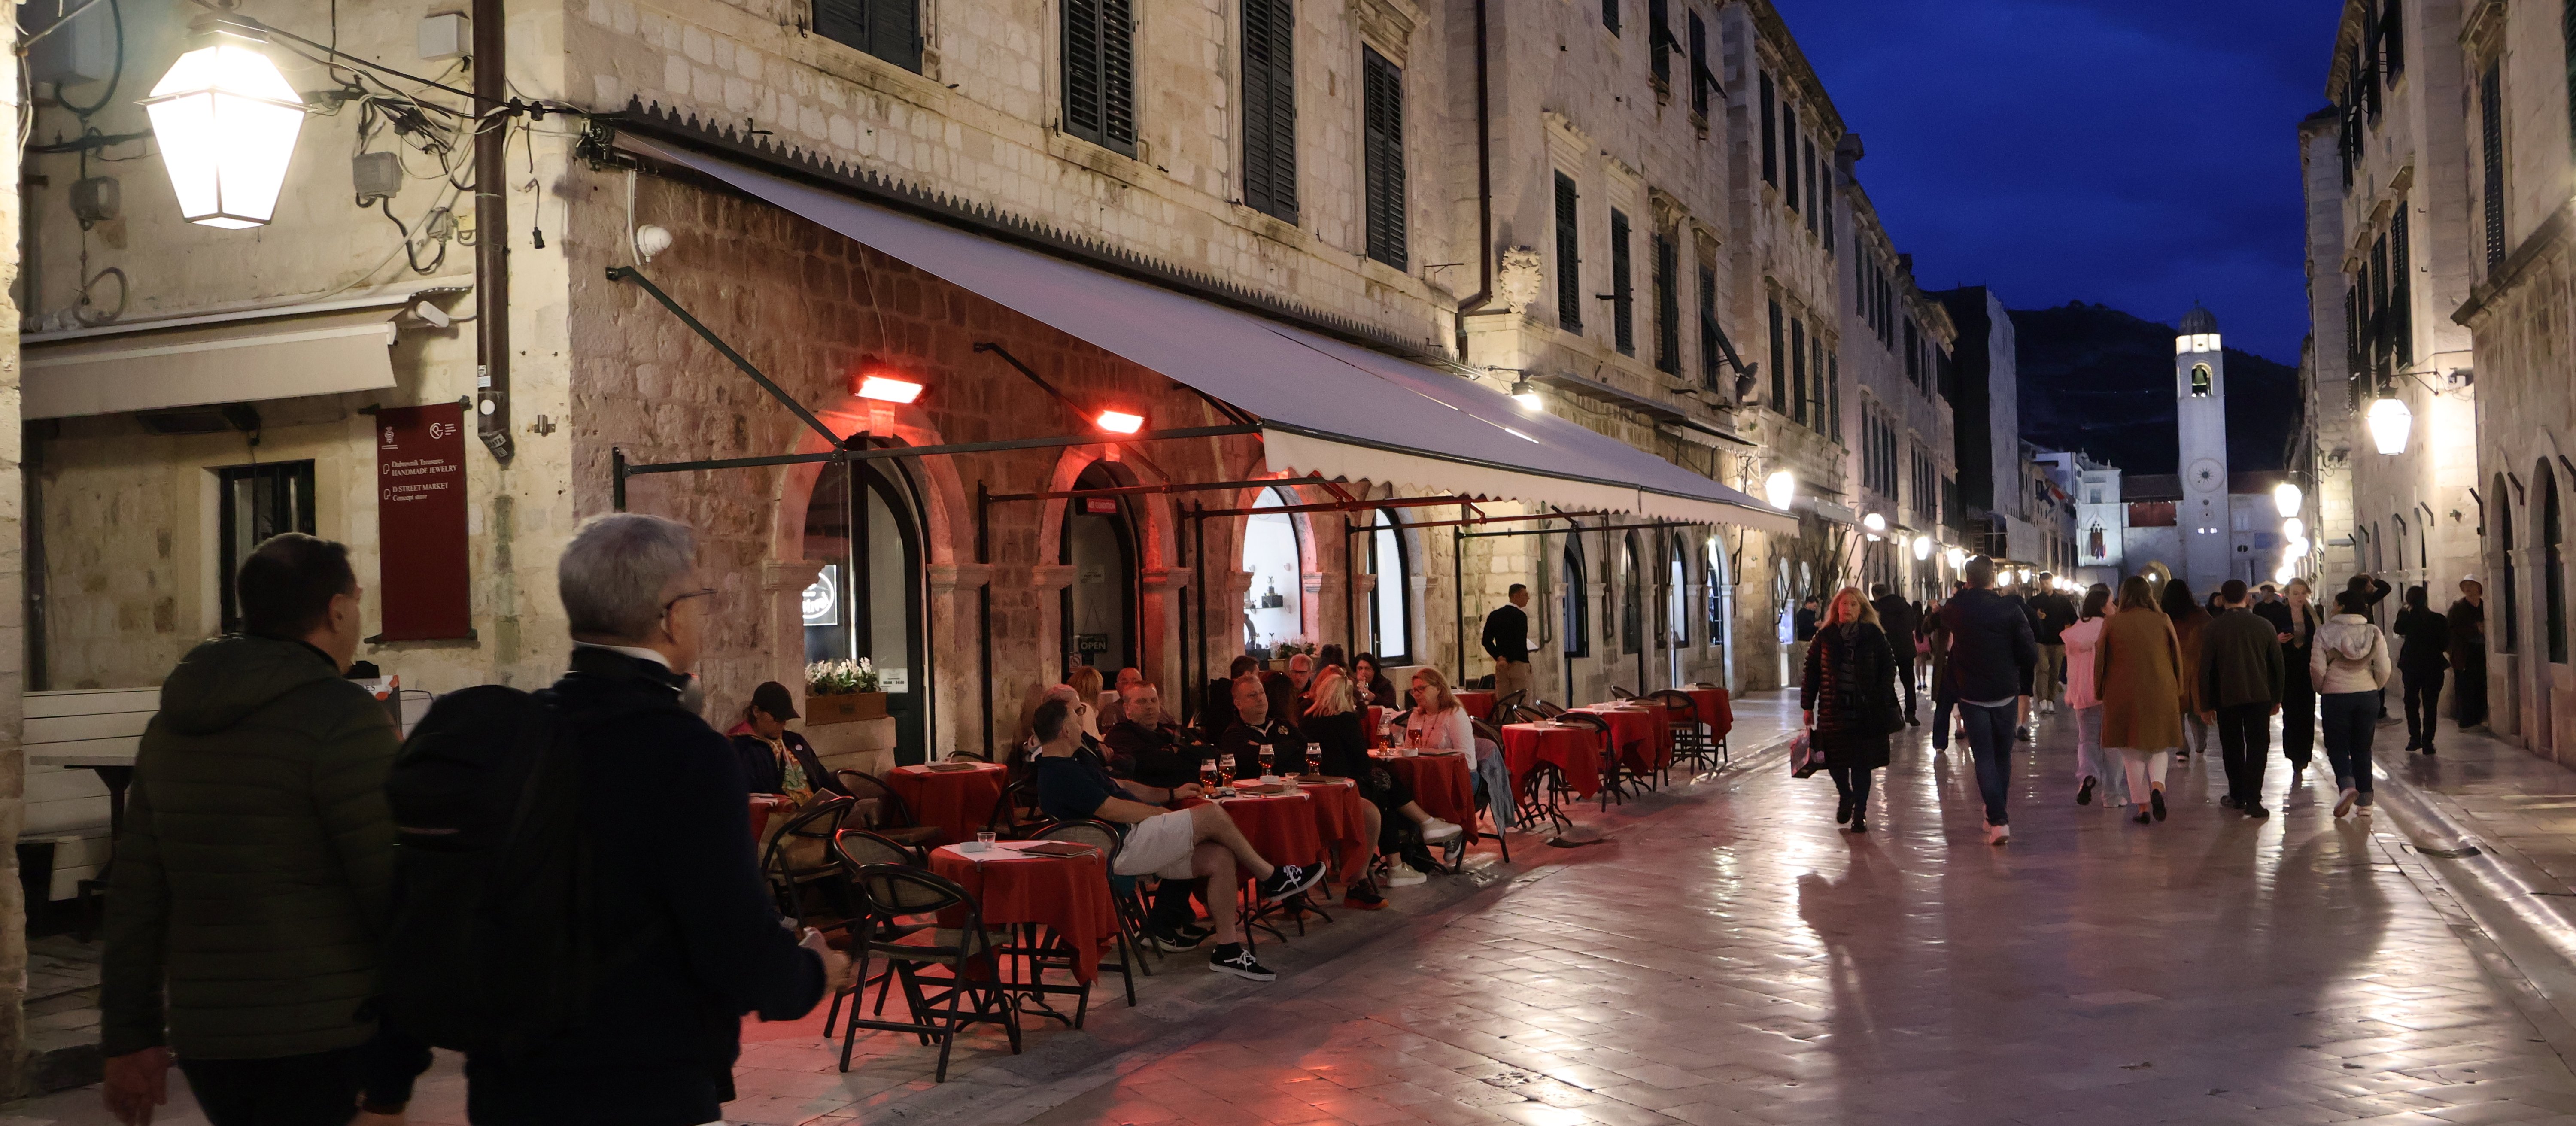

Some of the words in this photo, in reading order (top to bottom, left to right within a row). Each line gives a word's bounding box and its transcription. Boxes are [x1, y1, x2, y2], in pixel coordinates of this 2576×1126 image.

[392, 467, 428, 476] HANDMADE
[429, 465, 457, 473] JEWELRY
[422, 482, 448, 490] MARKET
